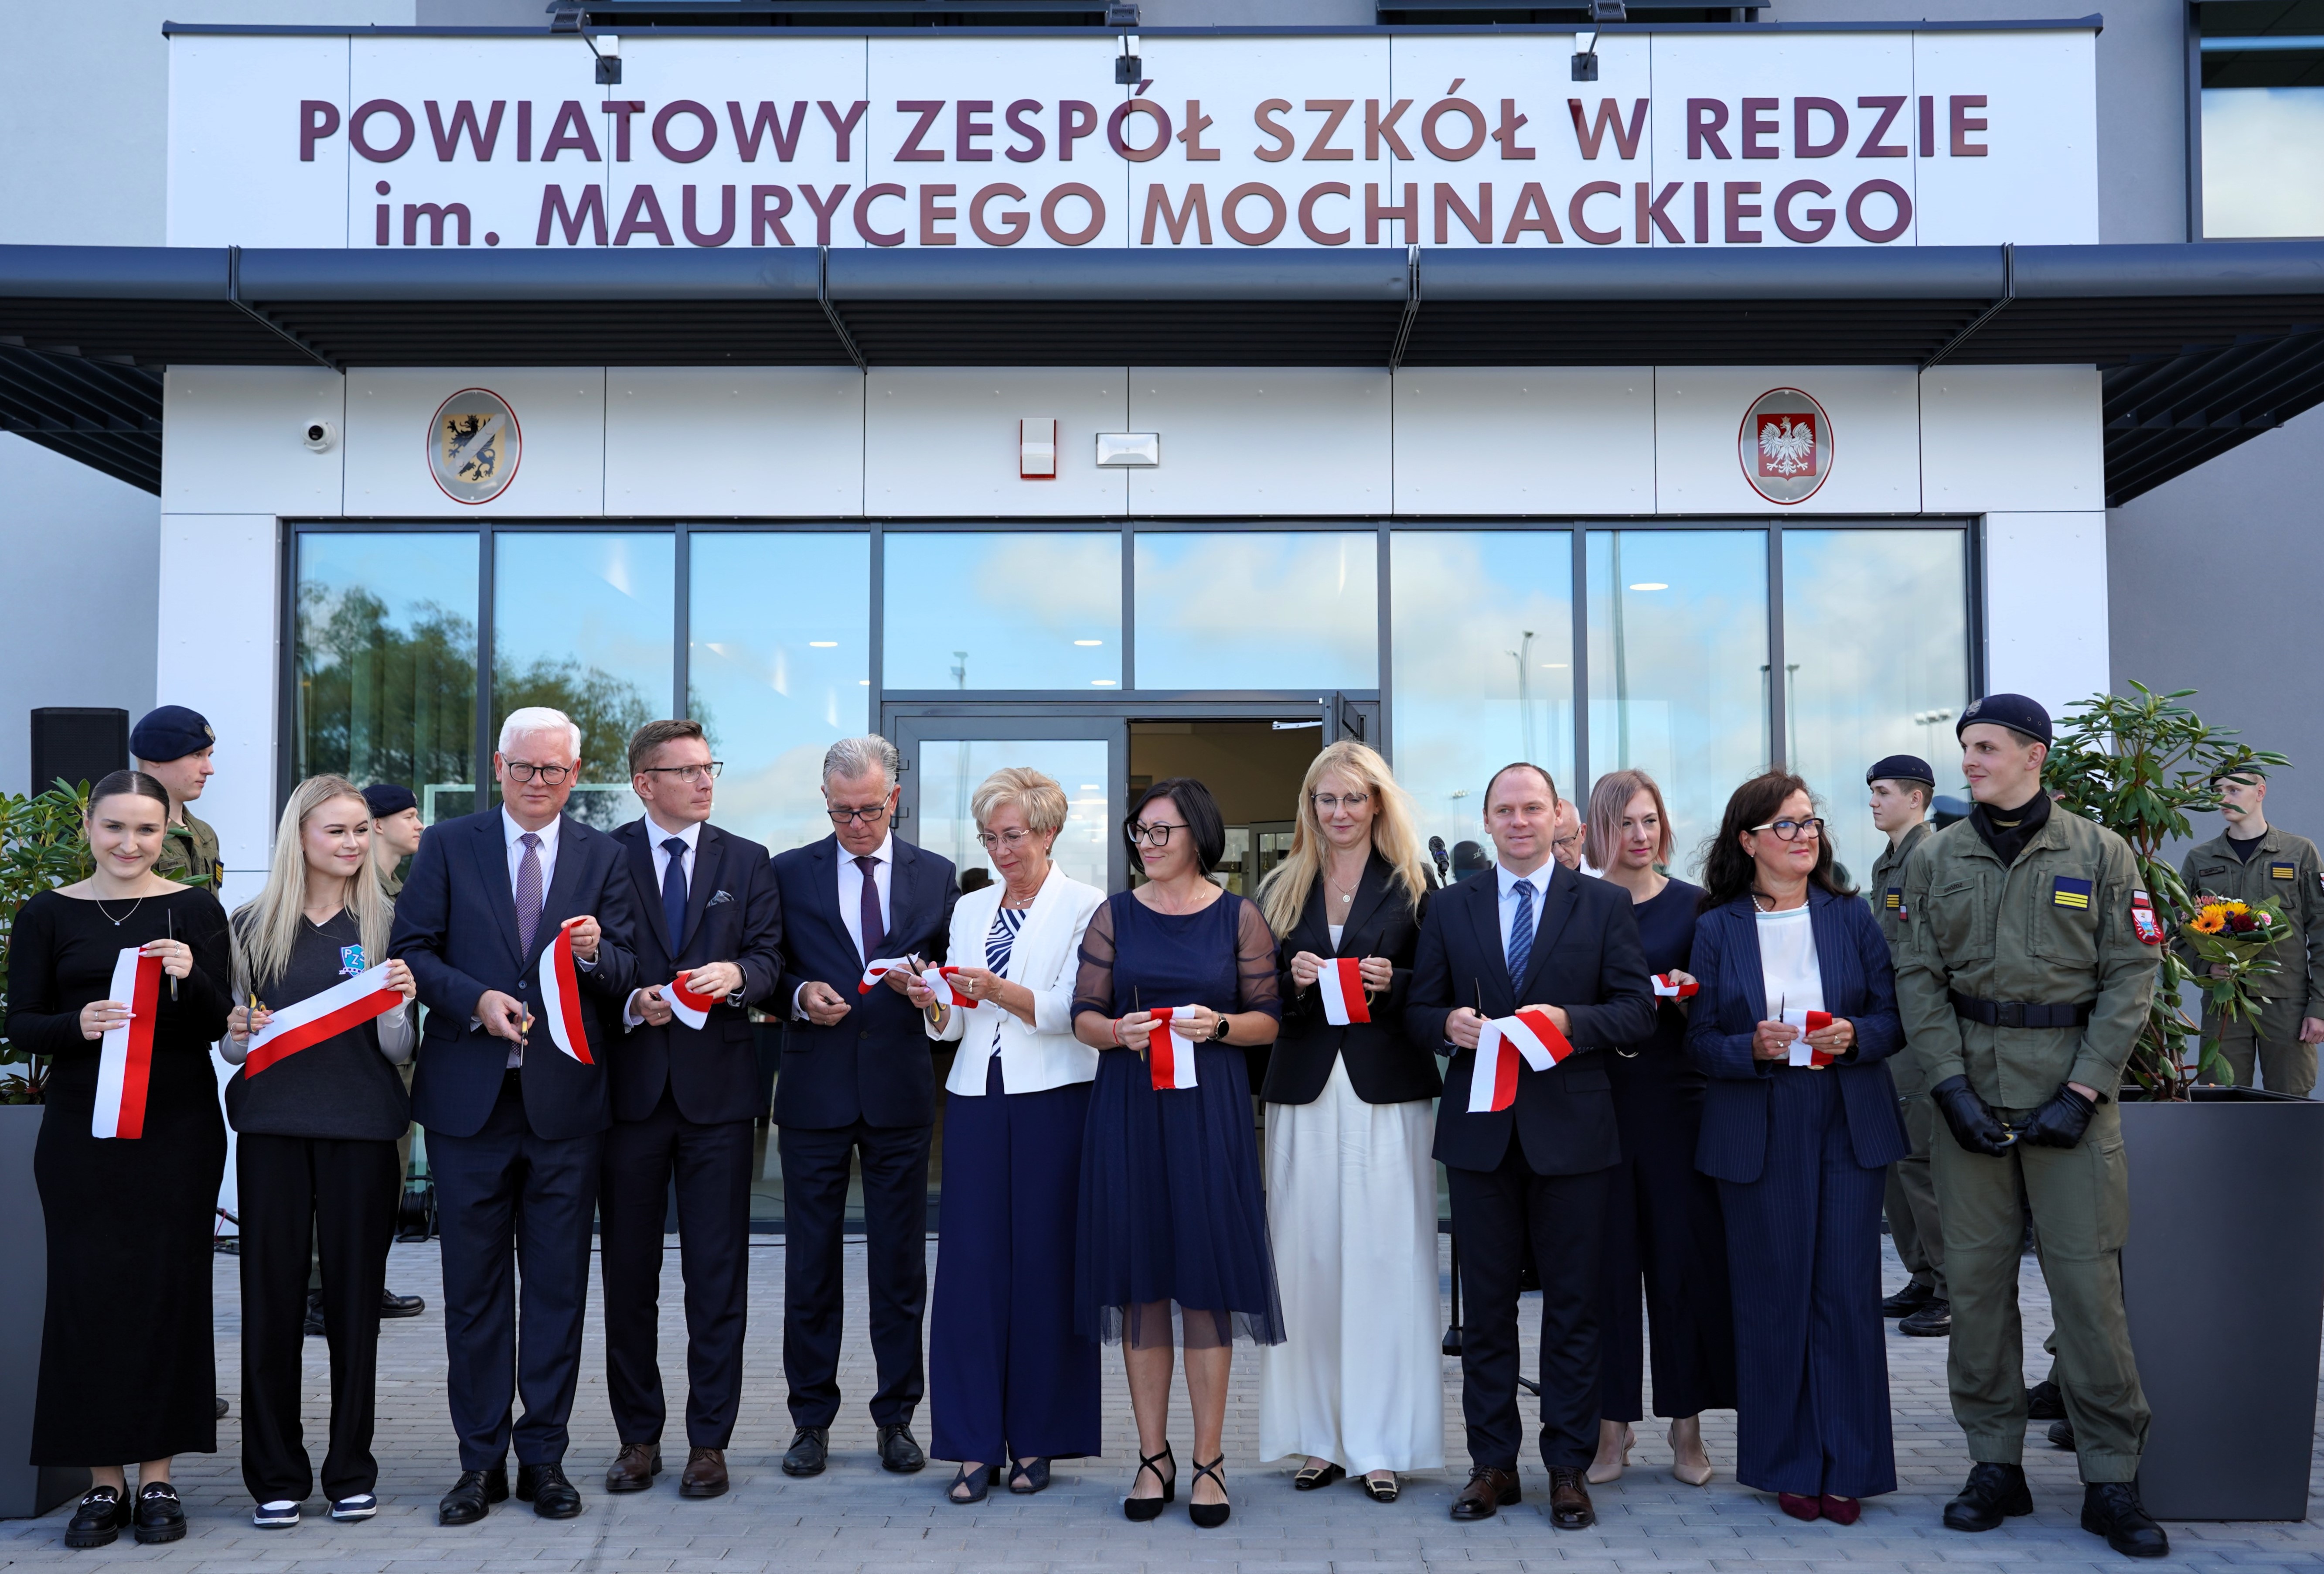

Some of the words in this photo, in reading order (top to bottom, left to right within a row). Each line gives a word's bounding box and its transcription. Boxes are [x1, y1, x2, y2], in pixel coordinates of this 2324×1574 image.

[300, 99, 869, 162] POWIATOWY
[894, 79, 1220, 162] ZESPÓŁ
[1254, 78, 1536, 161] SZKÓŁ
[1568, 98, 1650, 159] W
[1687, 95, 1988, 159] REDZIE
[375, 181, 499, 245] im.
[536, 182, 1106, 246] MAURYCEGO
[1140, 179, 1913, 246] MOCHNACKIEGO
